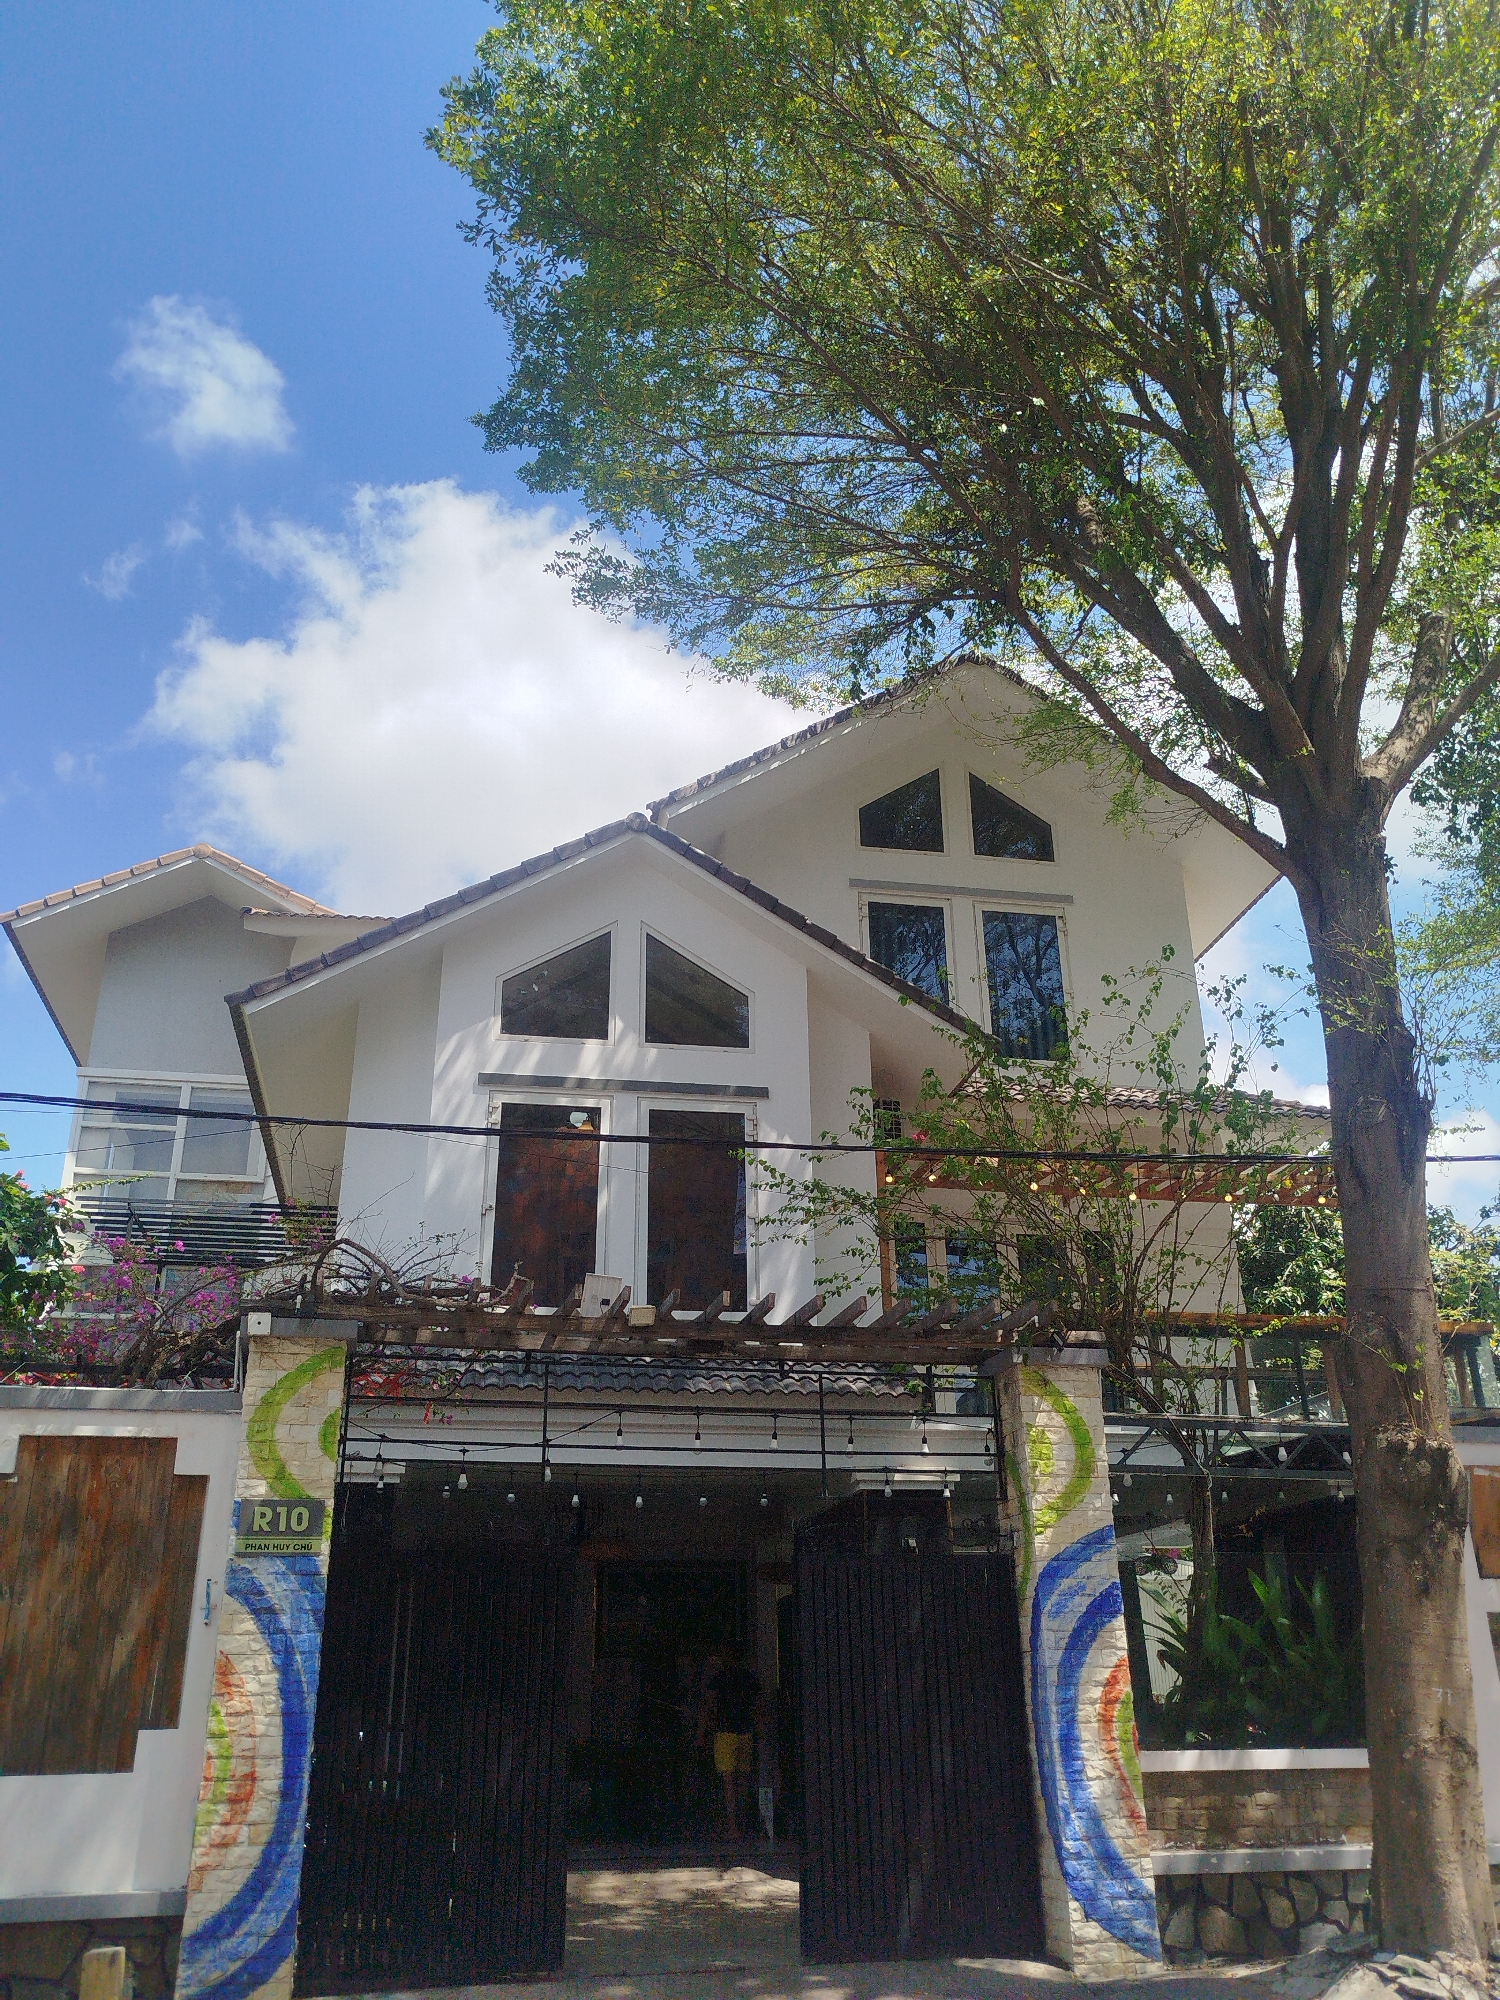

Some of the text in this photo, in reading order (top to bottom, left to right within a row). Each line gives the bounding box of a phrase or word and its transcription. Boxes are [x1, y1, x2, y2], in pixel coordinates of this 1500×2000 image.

[253, 1506, 310, 1532] R10
[244, 1543, 271, 1551] PHAN
[272, 1543, 291, 1551] HUY
